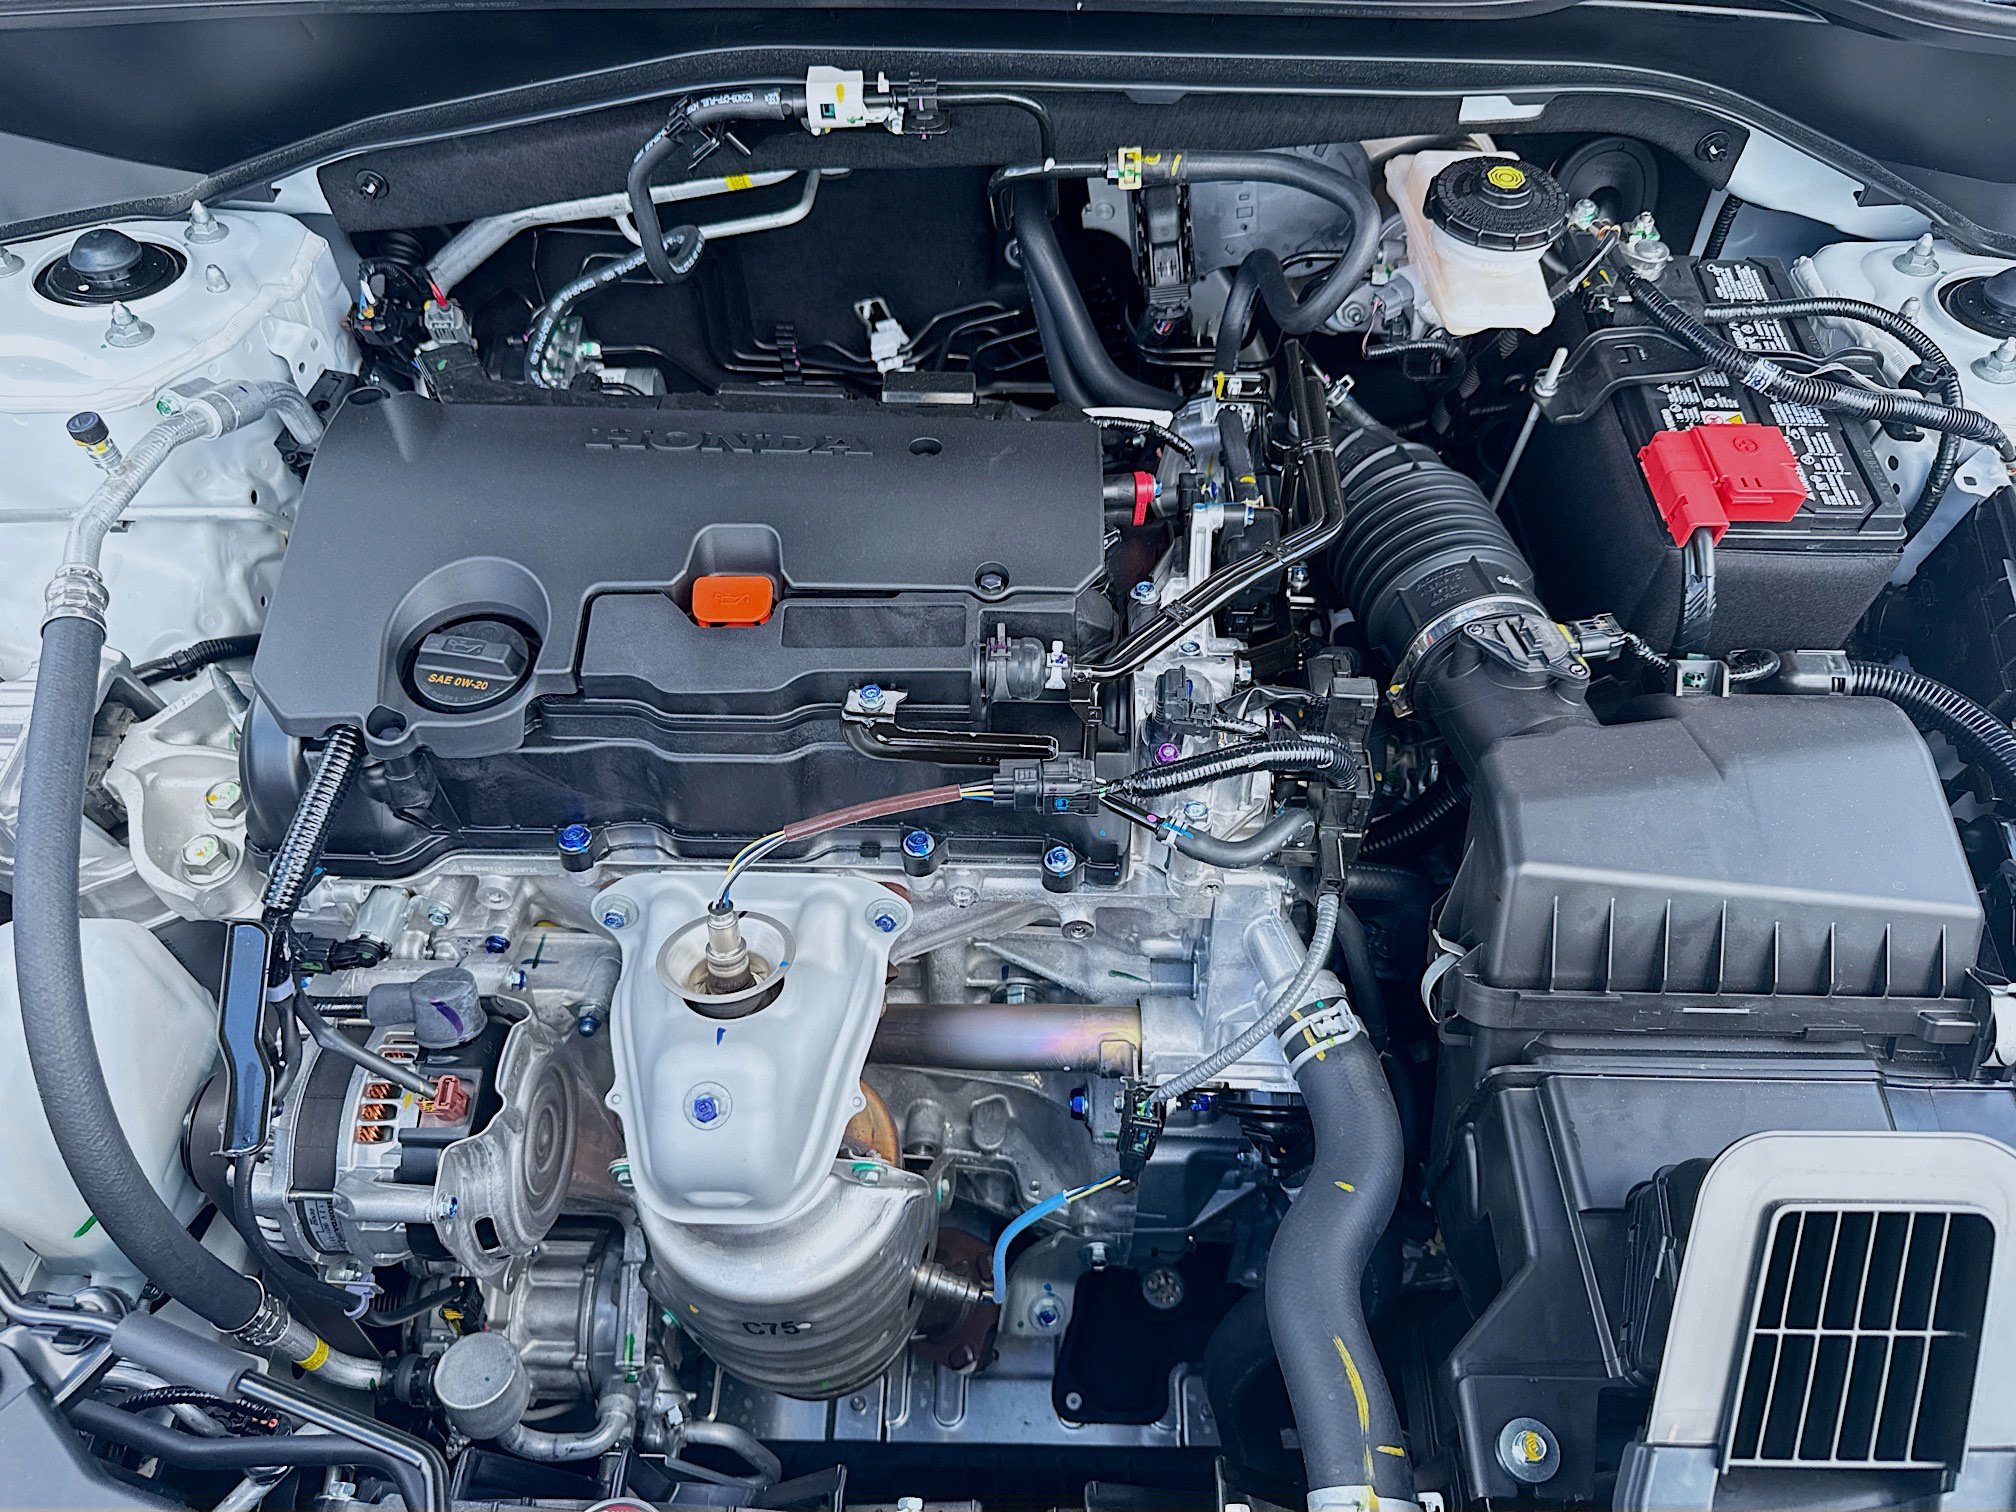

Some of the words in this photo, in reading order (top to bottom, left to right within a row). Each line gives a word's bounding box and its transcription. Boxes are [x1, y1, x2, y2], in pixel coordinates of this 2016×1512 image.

[585, 428, 874, 456] HONDA
[428, 673, 454, 685] SAE
[454, 676, 489, 691] 0W-20
[742, 1321, 801, 1336] C75
